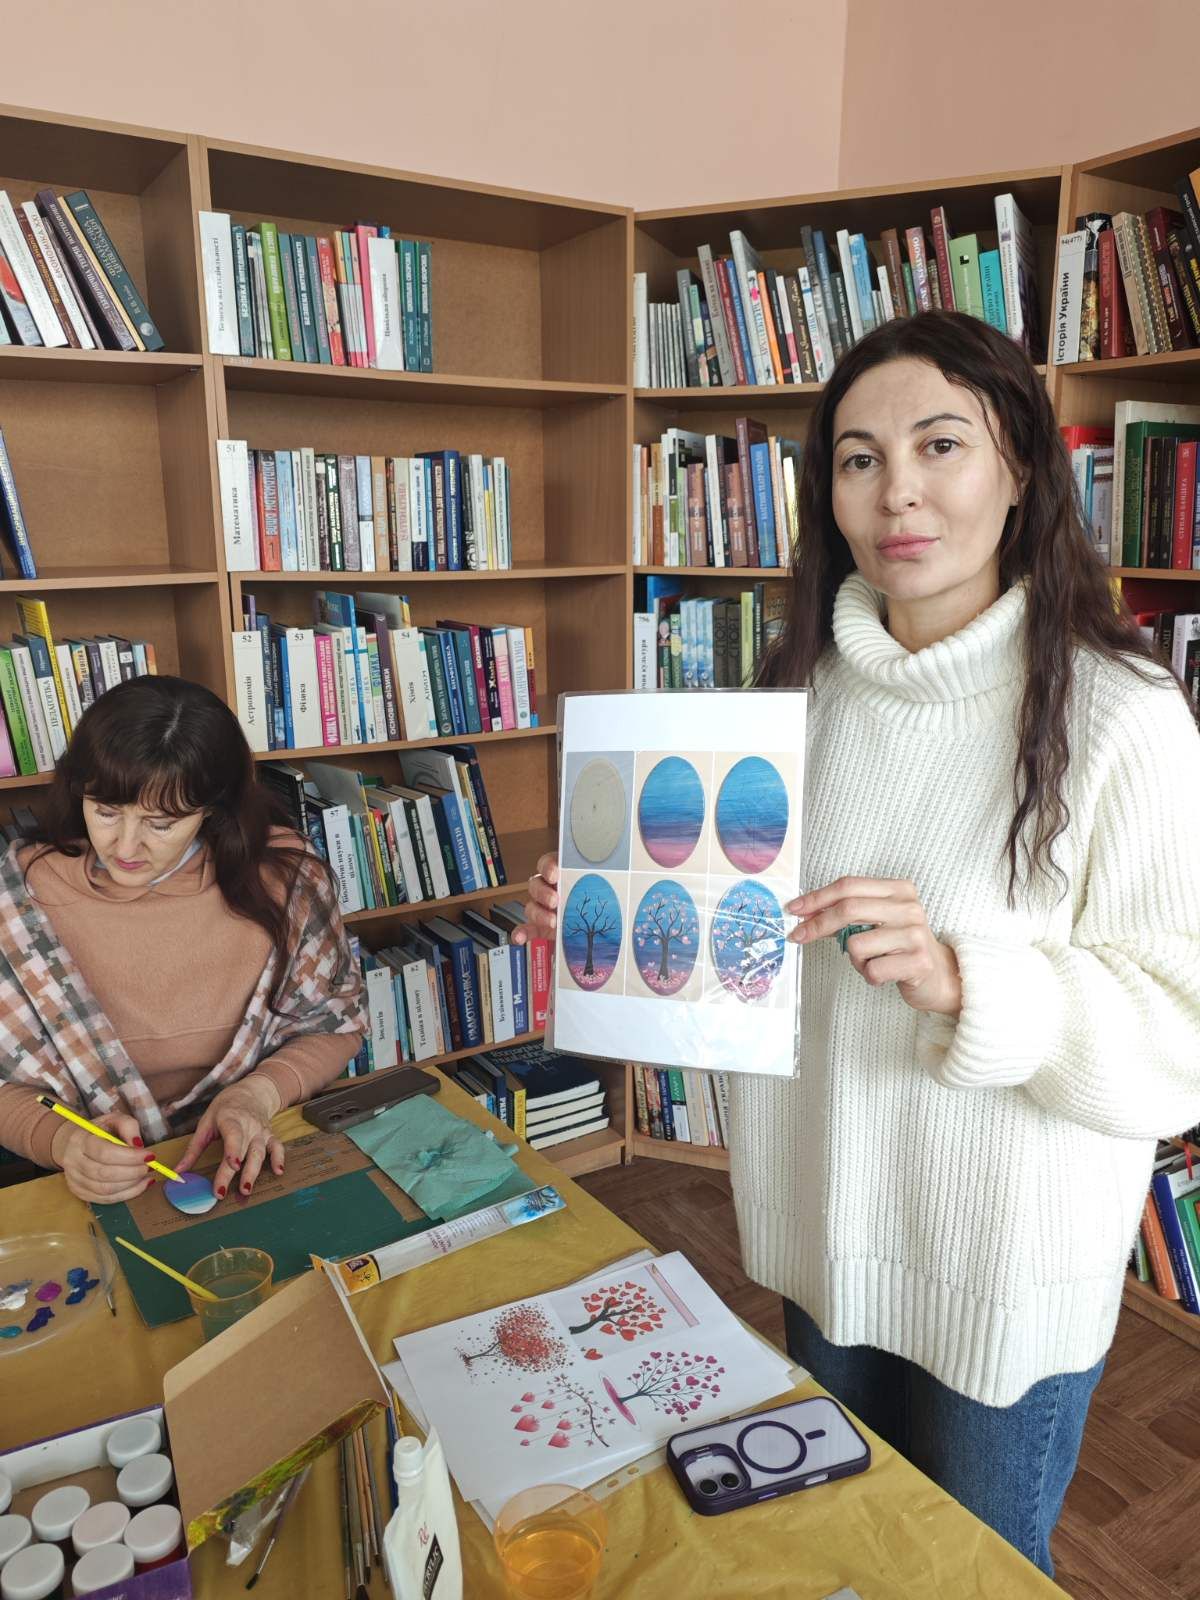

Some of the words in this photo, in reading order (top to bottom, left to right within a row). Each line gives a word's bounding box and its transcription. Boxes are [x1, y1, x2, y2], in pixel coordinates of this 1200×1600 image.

[1059, 272, 1070, 319] України
[1057, 322, 1068, 361] Історія
[231, 488, 241, 544] Математика
[514, 640, 524, 663] ХІМІЯ
[715, 616, 726, 656] СПОРТ
[728, 617, 739, 658] СПОРТ
[369, 653, 380, 687] ФІЗИКА
[641, 640, 650, 673] культура
[244, 676, 255, 725] Астрономія
[299, 683, 307, 712] Фізика
[384, 669, 393, 699] ФІЗИКИ
[408, 682, 416, 704] Хімія
[517, 666, 527, 708] ОРГАНІЧНА
[43, 680, 59, 727] ПЕДАГОГІКА
[387, 701, 396, 734] ОСНОВИ
[347, 854, 355, 878] цілому
[414, 990, 423, 1012] цілому
[462, 972, 478, 1040] РАДІОТЕХНІКА
[417, 1020, 426, 1046] Техніка
